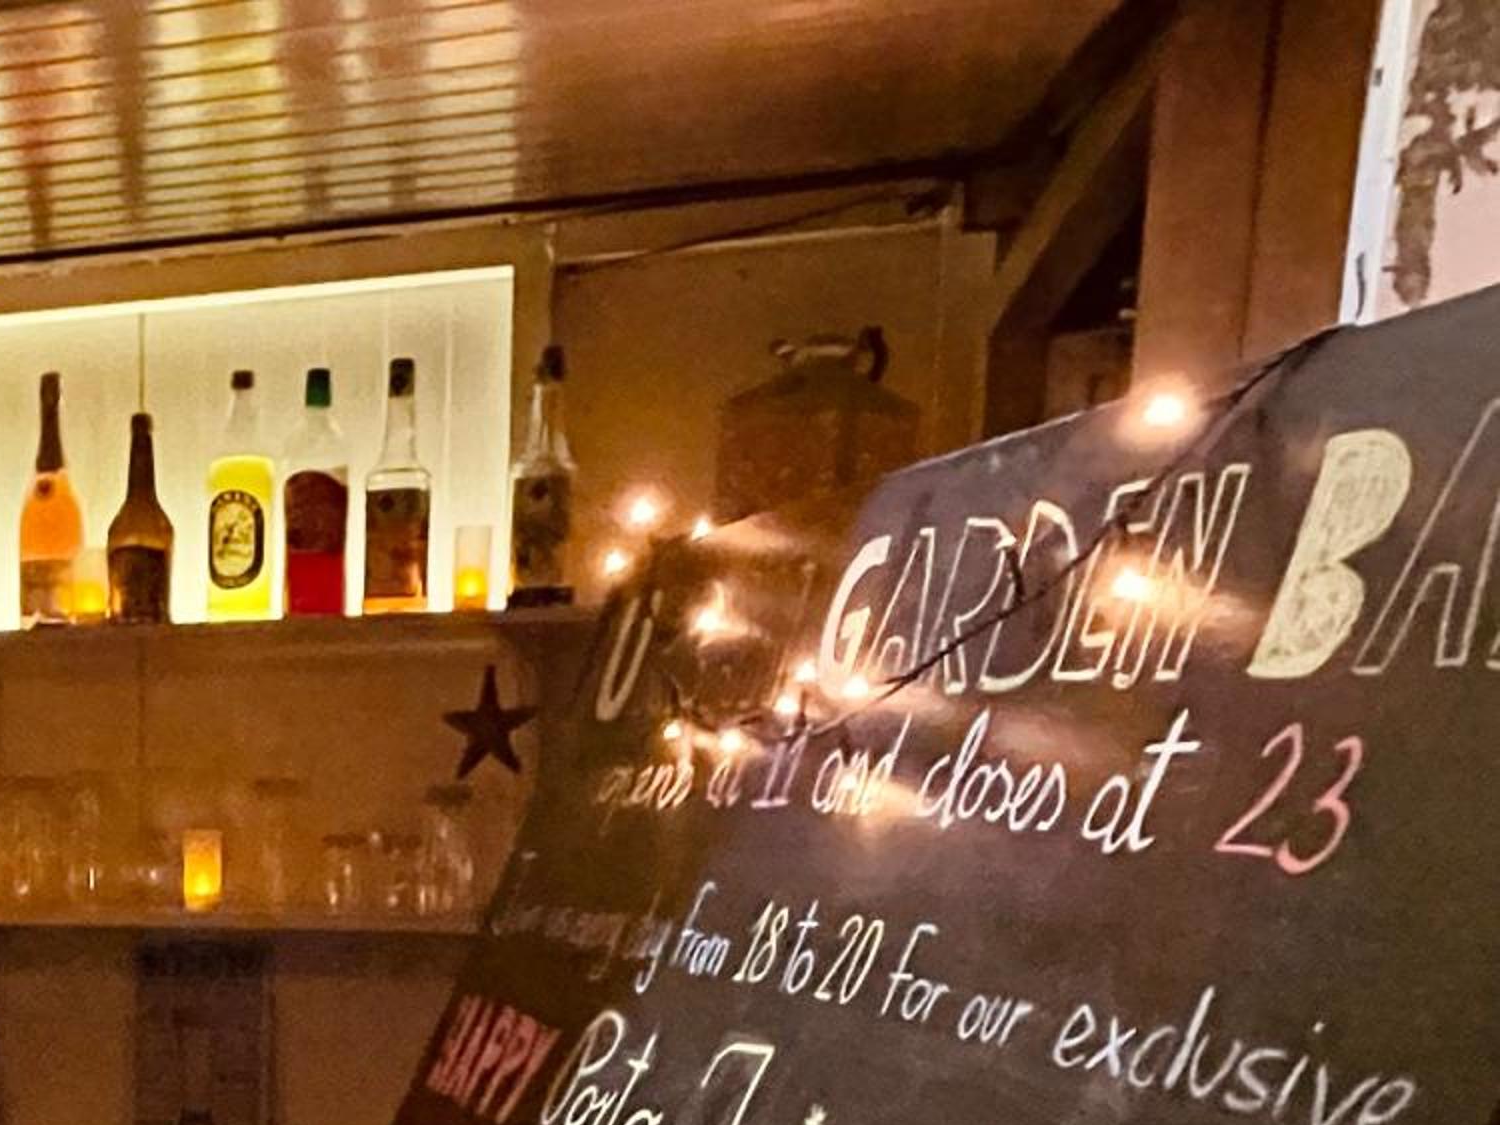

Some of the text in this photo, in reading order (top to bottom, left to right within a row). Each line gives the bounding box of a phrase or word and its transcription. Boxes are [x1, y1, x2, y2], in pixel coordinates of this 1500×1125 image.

[817, 463, 1252, 698] GARDEN
[1246, 397, 1500, 680] BA
[811, 712, 912, 816] and
[916, 708, 1069, 832] closes
[1081, 708, 1201, 854] at
[1213, 721, 1364, 875] 23
[732, 900, 790, 984] 18
[778, 900, 819, 995] to
[812, 914, 884, 1006] 20
[880, 922, 950, 1020] for
[956, 994, 1034, 1046] our
